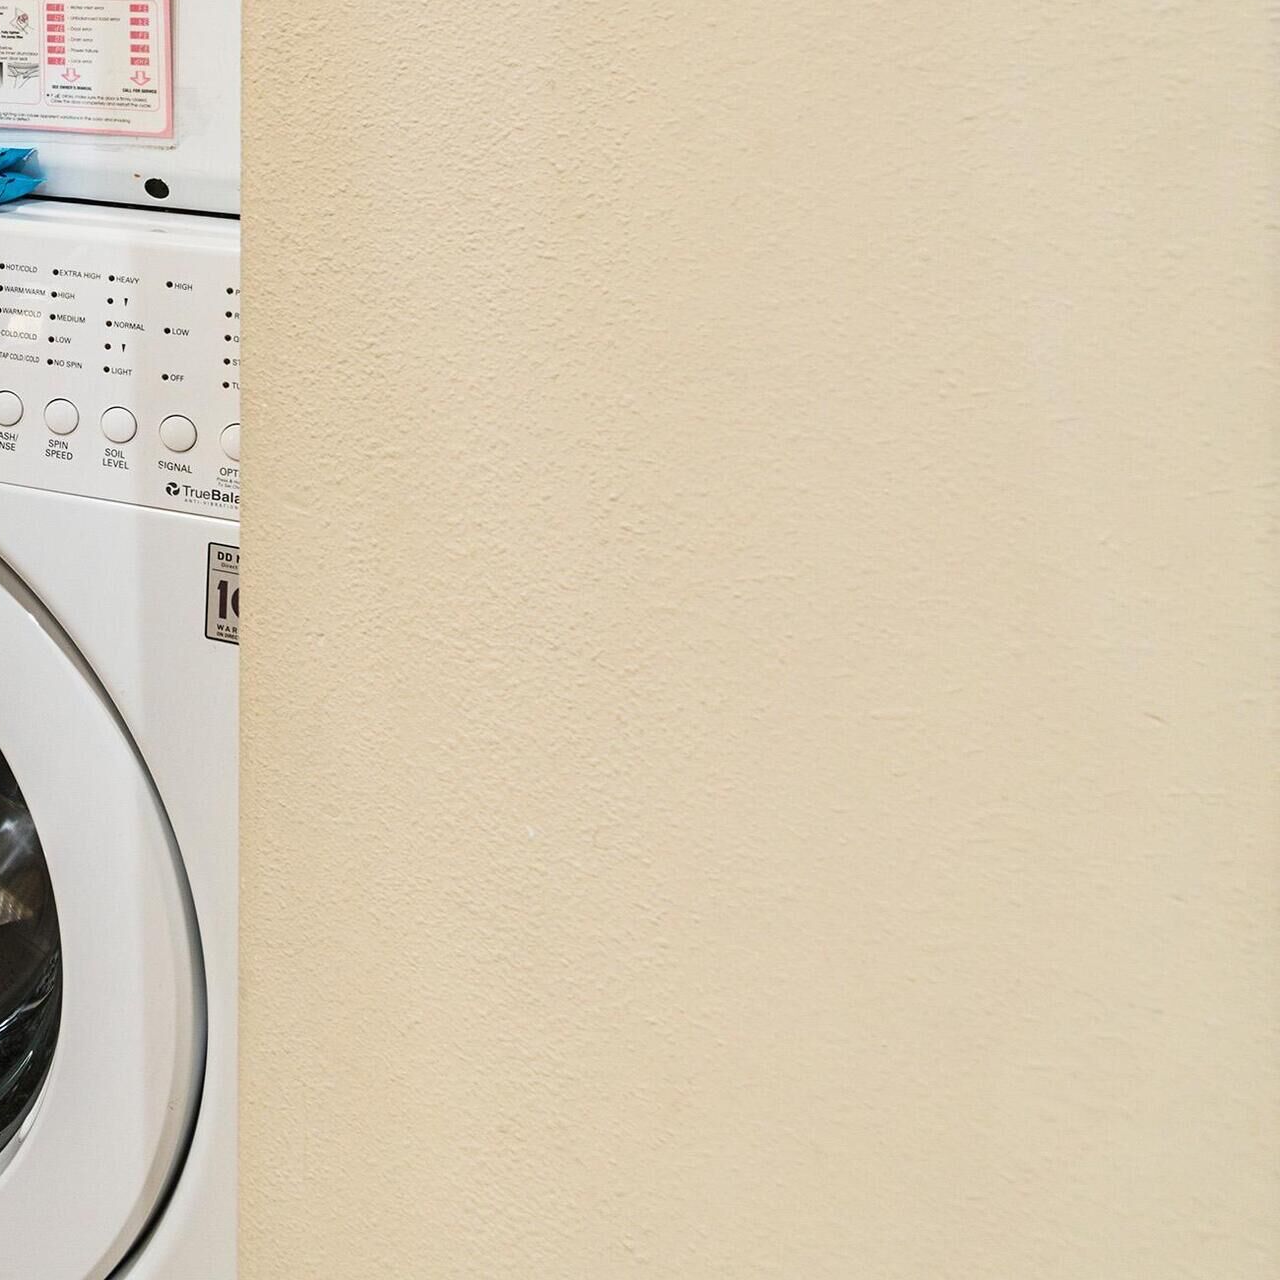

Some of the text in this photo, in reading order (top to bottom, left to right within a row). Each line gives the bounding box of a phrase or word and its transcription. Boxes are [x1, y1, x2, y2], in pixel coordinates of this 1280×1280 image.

[5, 263, 38, 273] HOT/COLD
[59, 269, 102, 280] EXTRA HIGH
[116, 275, 140, 284] HEAVY
[4, 285, 46, 296] WARM/WARM
[174, 282, 193, 291] HIGH
[58, 291, 76, 300] HIGH
[2, 307, 42, 318] WARM/COLD
[57, 314, 86, 324] MEDIUM
[113, 320, 145, 331] NORMAL
[0, 329, 38, 340] COLD/COLD
[171, 328, 190, 337] LOW
[55, 336, 72, 344] LOW
[0, 351, 9, 359] TAP
[54, 359, 83, 369] NO SPIN
[111, 367, 133, 376] LIGHT
[170, 374, 184, 382] OFF
[48, 439, 69, 450] SPIN
[45, 449, 74, 461] SPEED
[104, 448, 126, 459] SOIL
[102, 458, 130, 470] LEVEL
[158, 460, 193, 474] SIGNAL
[219, 467, 240, 477] OPT
[217, 551, 233, 562] DD
